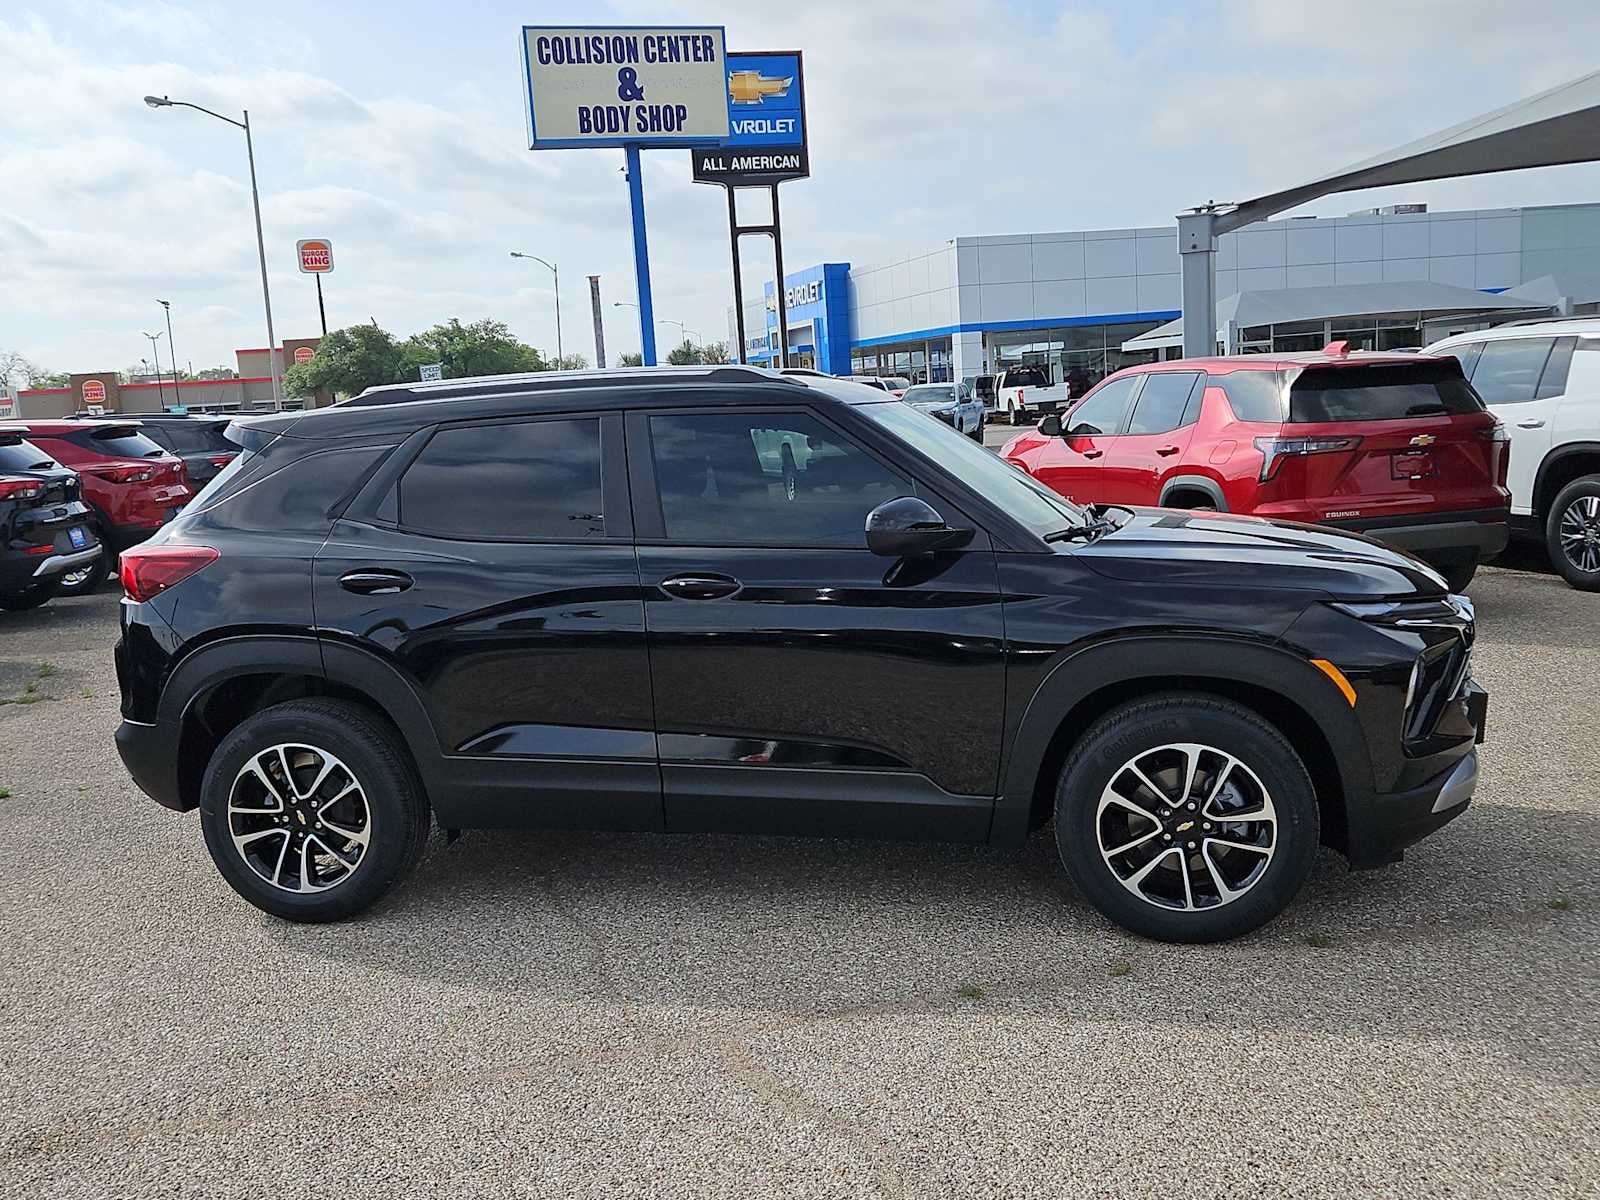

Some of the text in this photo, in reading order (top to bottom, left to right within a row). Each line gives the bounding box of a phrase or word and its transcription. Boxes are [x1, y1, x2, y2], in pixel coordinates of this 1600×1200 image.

[537, 35, 715, 65] COLLISION CENTER
[617, 66, 645, 102] &
[578, 105, 687, 134] BODY SHOP
[731, 119, 796, 134] VROLET
[702, 155, 800, 171] ALL AMERICAN
[302, 257, 329, 265] KING
